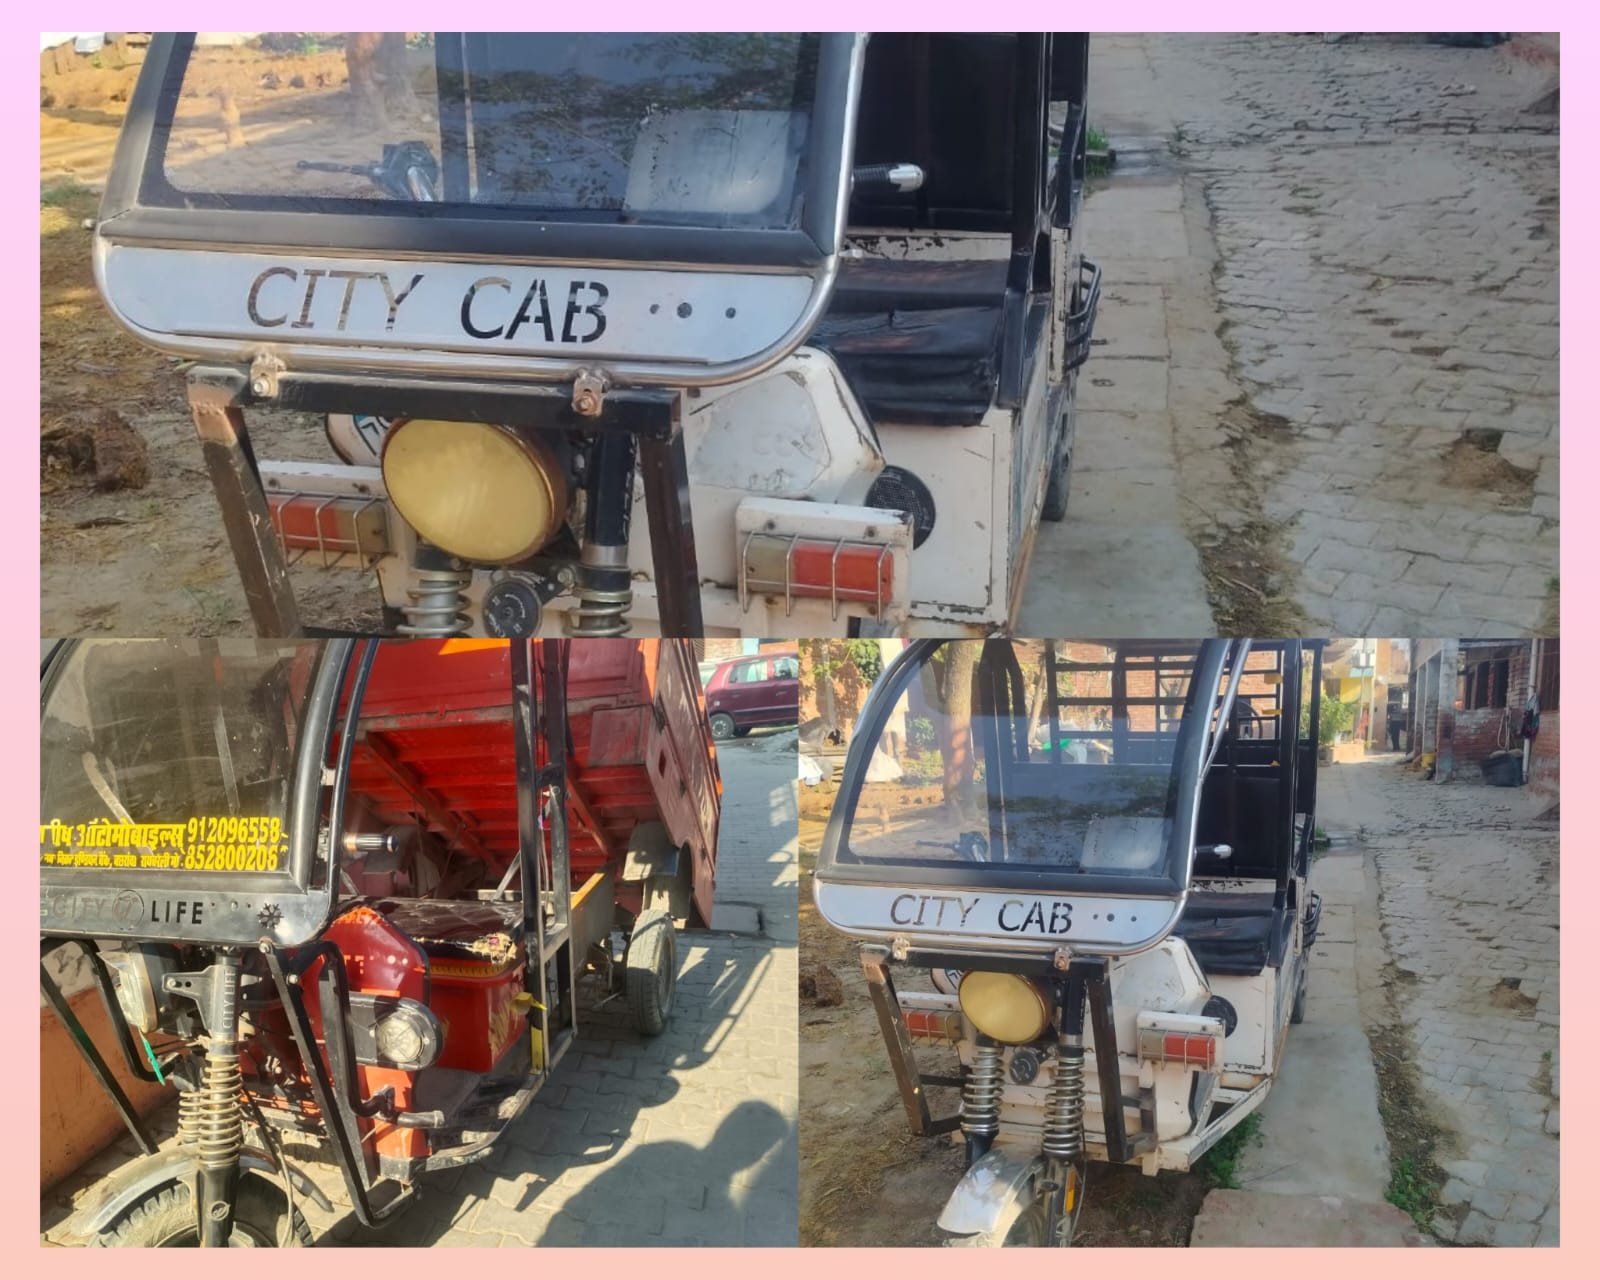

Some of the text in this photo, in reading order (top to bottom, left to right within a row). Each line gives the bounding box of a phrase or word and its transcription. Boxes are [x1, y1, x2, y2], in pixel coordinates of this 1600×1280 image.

[246, 266, 609, 344] CITY CAB
[187, 816, 289, 844] 912096558
[184, 844, 289, 871] 852800206
[53, 894, 106, 919] CITY
[151, 900, 203, 925] LIFE
[890, 894, 1074, 934] CITY CAB
[222, 969, 237, 1029] CITY LIFE
